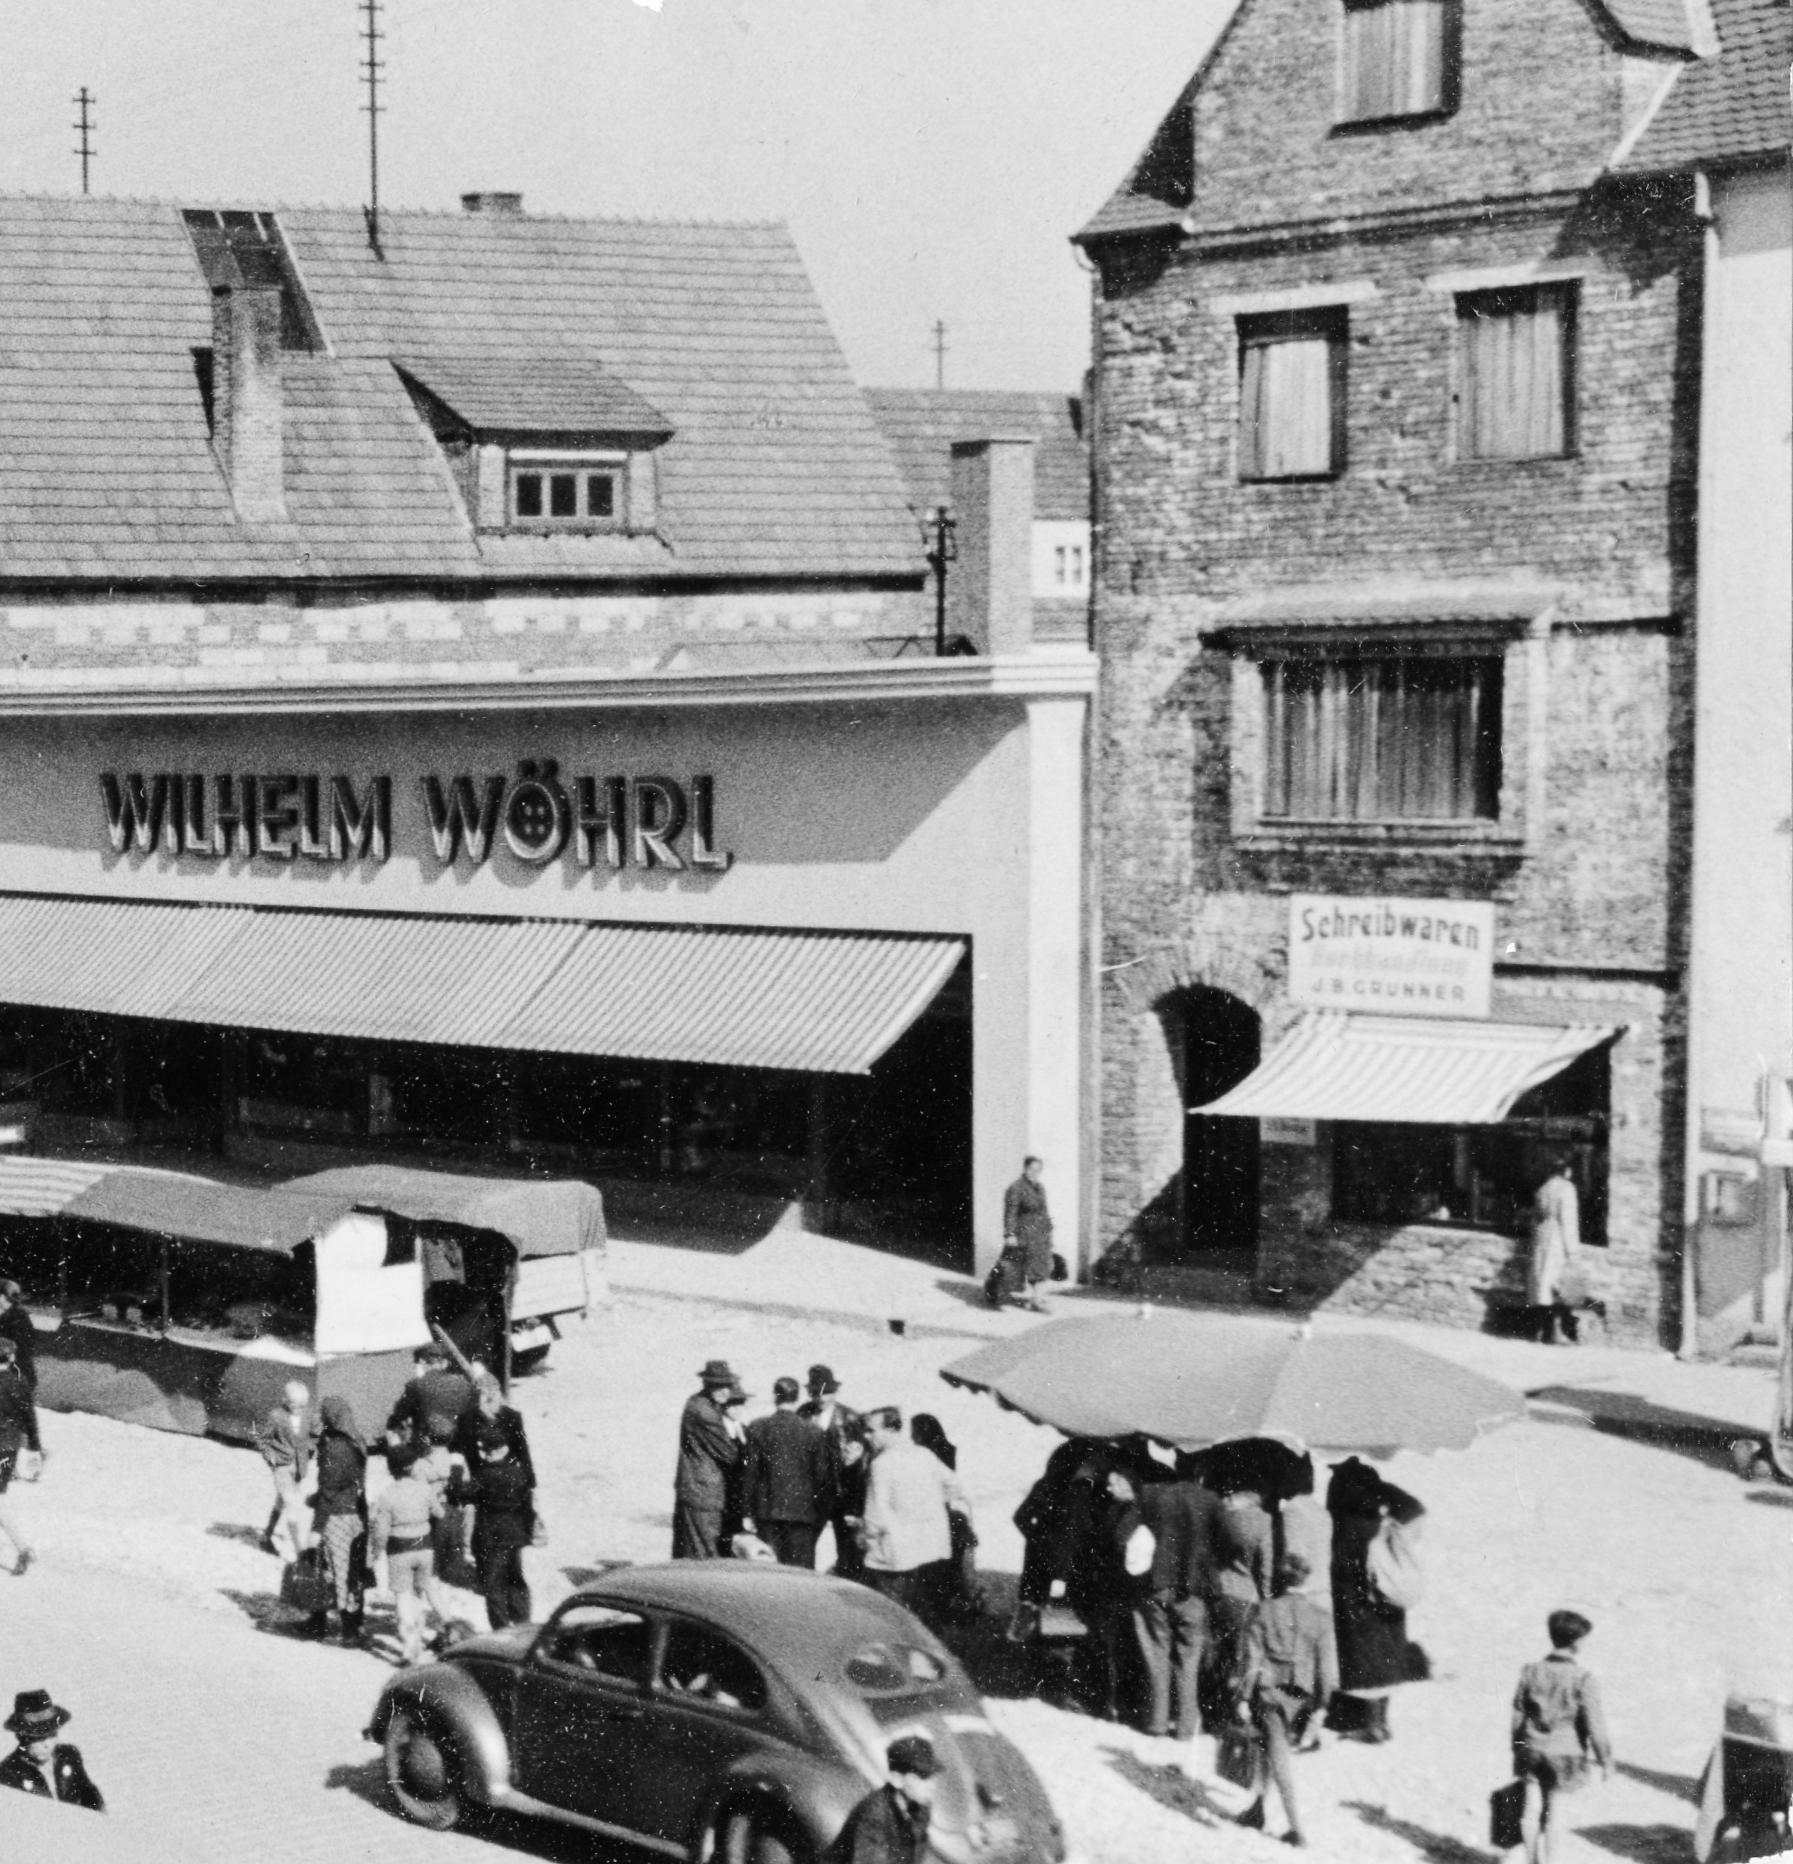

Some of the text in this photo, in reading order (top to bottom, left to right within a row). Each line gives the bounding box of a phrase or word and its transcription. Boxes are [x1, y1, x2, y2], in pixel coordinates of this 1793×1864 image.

[99, 758, 735, 870] WILHELM WÖHRL
[1301, 903, 1480, 950] Schreibwaren
